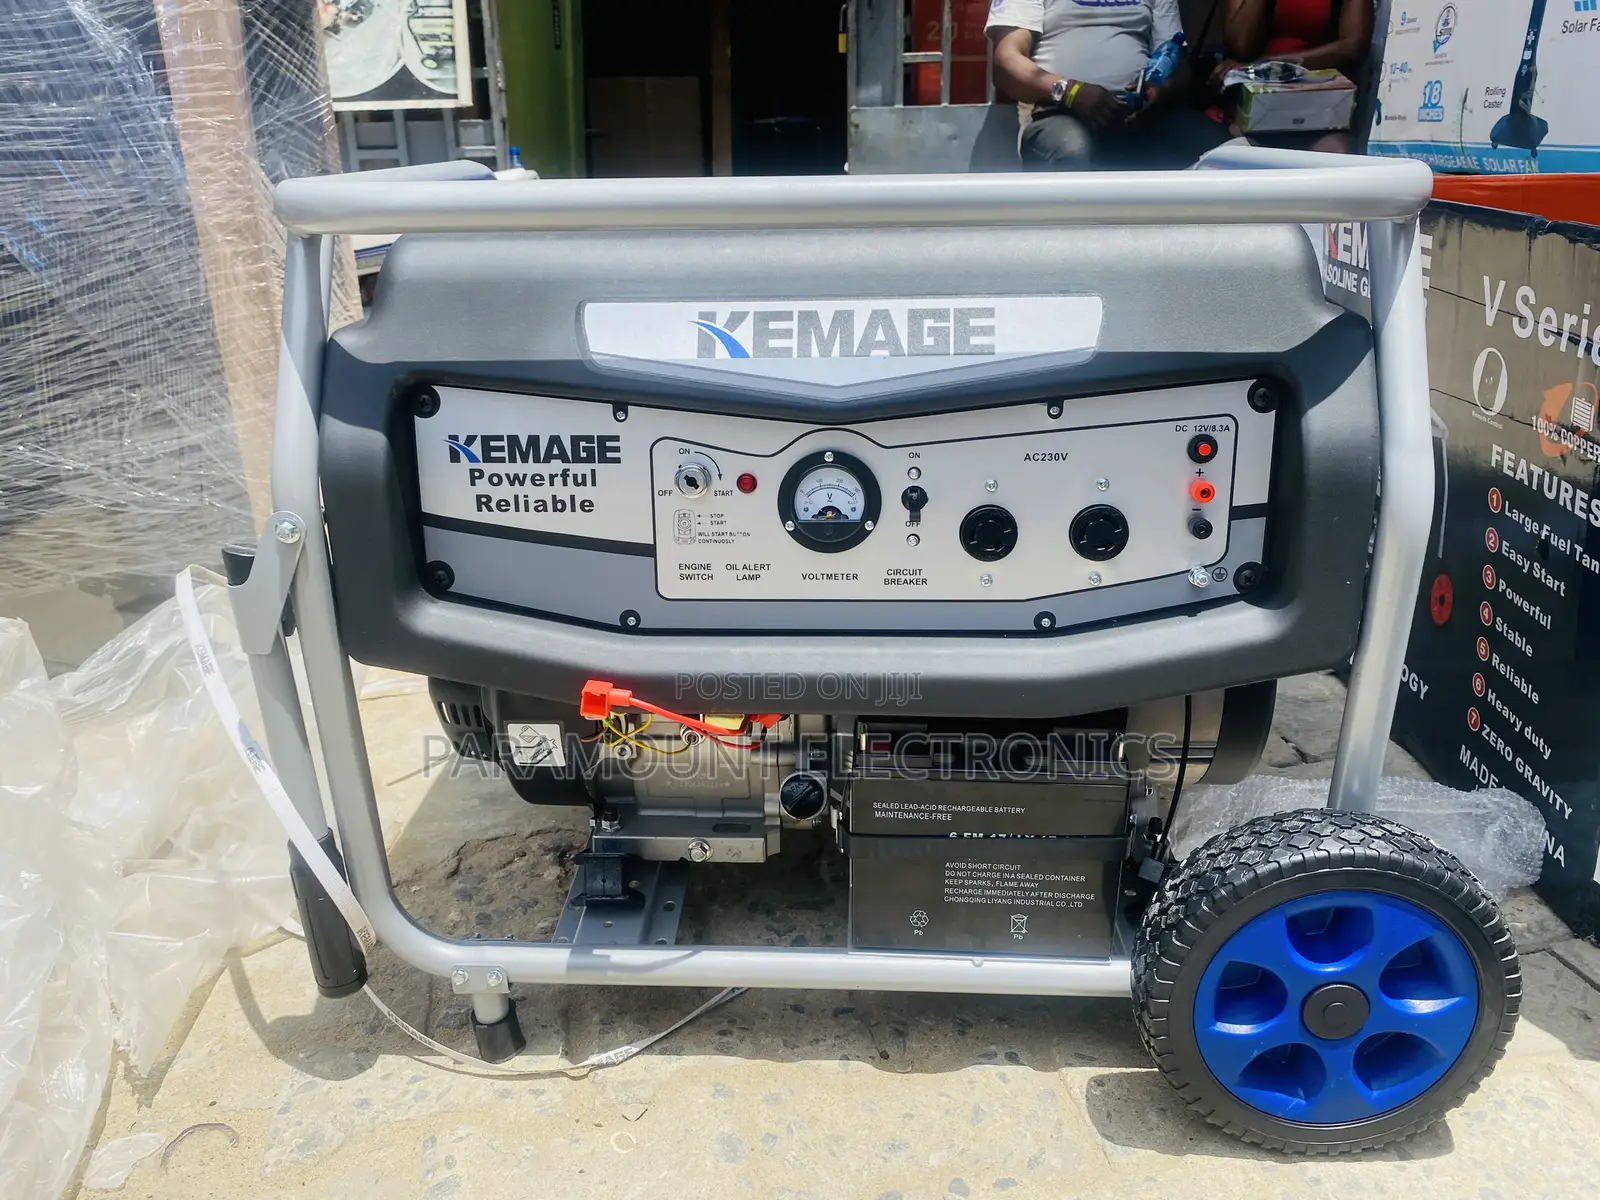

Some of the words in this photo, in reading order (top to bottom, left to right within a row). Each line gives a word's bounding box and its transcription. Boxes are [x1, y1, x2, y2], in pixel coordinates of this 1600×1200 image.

[1561, 19, 1588, 34] Solar
[1422, 80, 1443, 108] 18
[1485, 86, 1506, 97] Rolling
[1484, 99, 1503, 109] Caster
[1482, 157, 1517, 173] SOLAR
[1518, 159, 1540, 174] FAN
[1483, 275, 1506, 326] V
[689, 307, 996, 359] KEMAGE
[1175, 424, 1188, 432] DC
[1193, 424, 1230, 432] 12V/8.3A
[1531, 416, 1558, 441] 100%
[443, 434, 621, 464] KEMAGE
[1023, 452, 1068, 462] AC230V
[469, 468, 597, 487] Powerful
[1491, 444, 1600, 527] FEATURES
[475, 494, 595, 513] Reliable
[1505, 500, 1539, 534] Large
[1540, 524, 1570, 555] Fuel
[678, 563, 711, 571] ENGINE
[725, 563, 739, 571] OIL
[742, 563, 771, 571] ALERT
[886, 568, 922, 576] CIRCUIT
[1502, 540, 1530, 573] Easy
[1533, 562, 1566, 597] Start
[679, 573, 713, 581] SWITCH
[802, 573, 858, 581] VOLTMETER
[1499, 578, 1551, 630] Powerful
[1495, 616, 1533, 657] Stable
[1491, 652, 1539, 704] Reliable
[1487, 688, 1522, 732] Heavy
[1524, 726, 1551, 760] duty
[1481, 723, 1513, 761] ZERO
[1515, 757, 1573, 820] GRAVITY
[875, 811, 952, 820] MAINTENANCE-FREE
[900, 803, 937, 811] LEAD-ACID
[938, 804, 993, 813] RECHARGEABLE
[994, 806, 1026, 814] BATTERY
[995, 880, 1018, 888] FLAME
[1045, 874, 1086, 882] CONTAINER
[944, 887, 982, 895] RECHARGE
[983, 889, 1030, 897] IMMEDIATELY
[1054, 892, 1095, 900] DISCHARGE
[987, 897, 1012, 905] LIYANG
[1013, 898, 1054, 906] INDUSTRIAL
